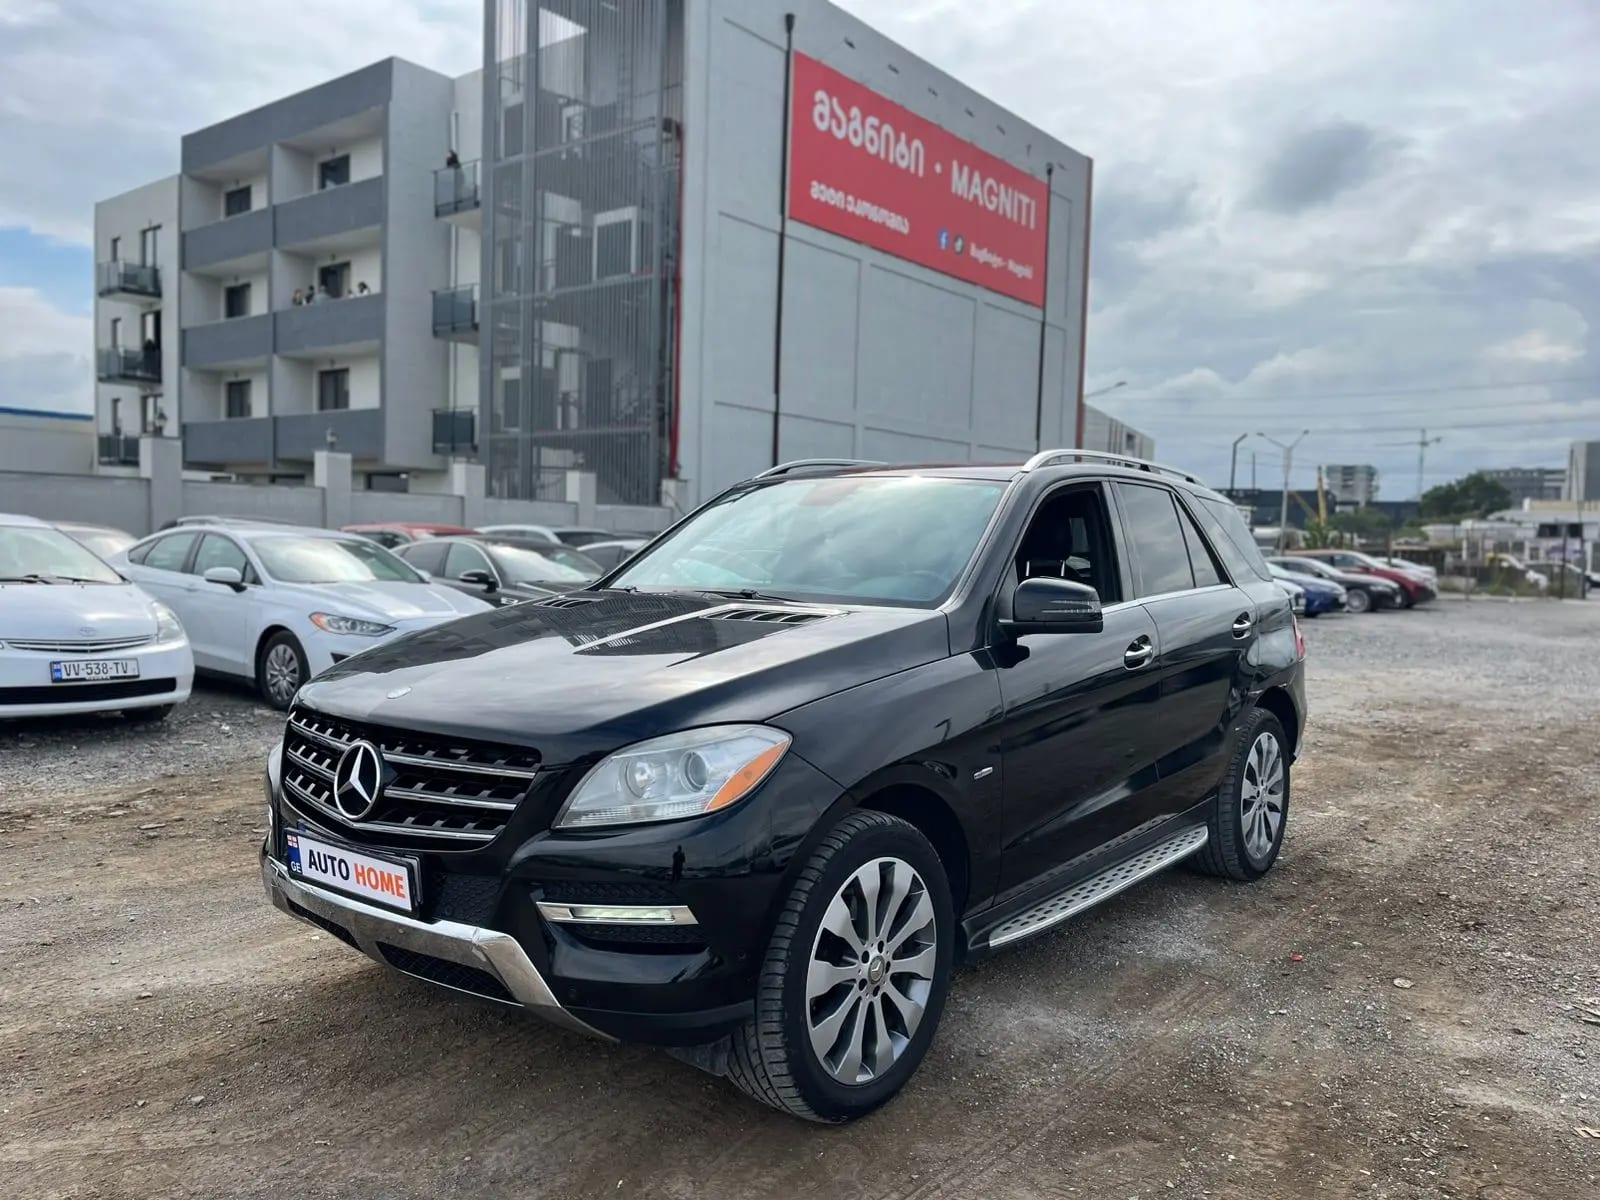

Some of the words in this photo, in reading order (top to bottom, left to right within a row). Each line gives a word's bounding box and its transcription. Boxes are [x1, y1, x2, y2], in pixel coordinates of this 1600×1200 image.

[812, 90, 925, 177] მაგნიტი
[952, 160, 1036, 229] MAGNITI
[63, 661, 128, 676] VV-538-TV
[290, 860, 302, 873] GE
[308, 849, 350, 881] AUTO
[354, 863, 406, 899] HOME
